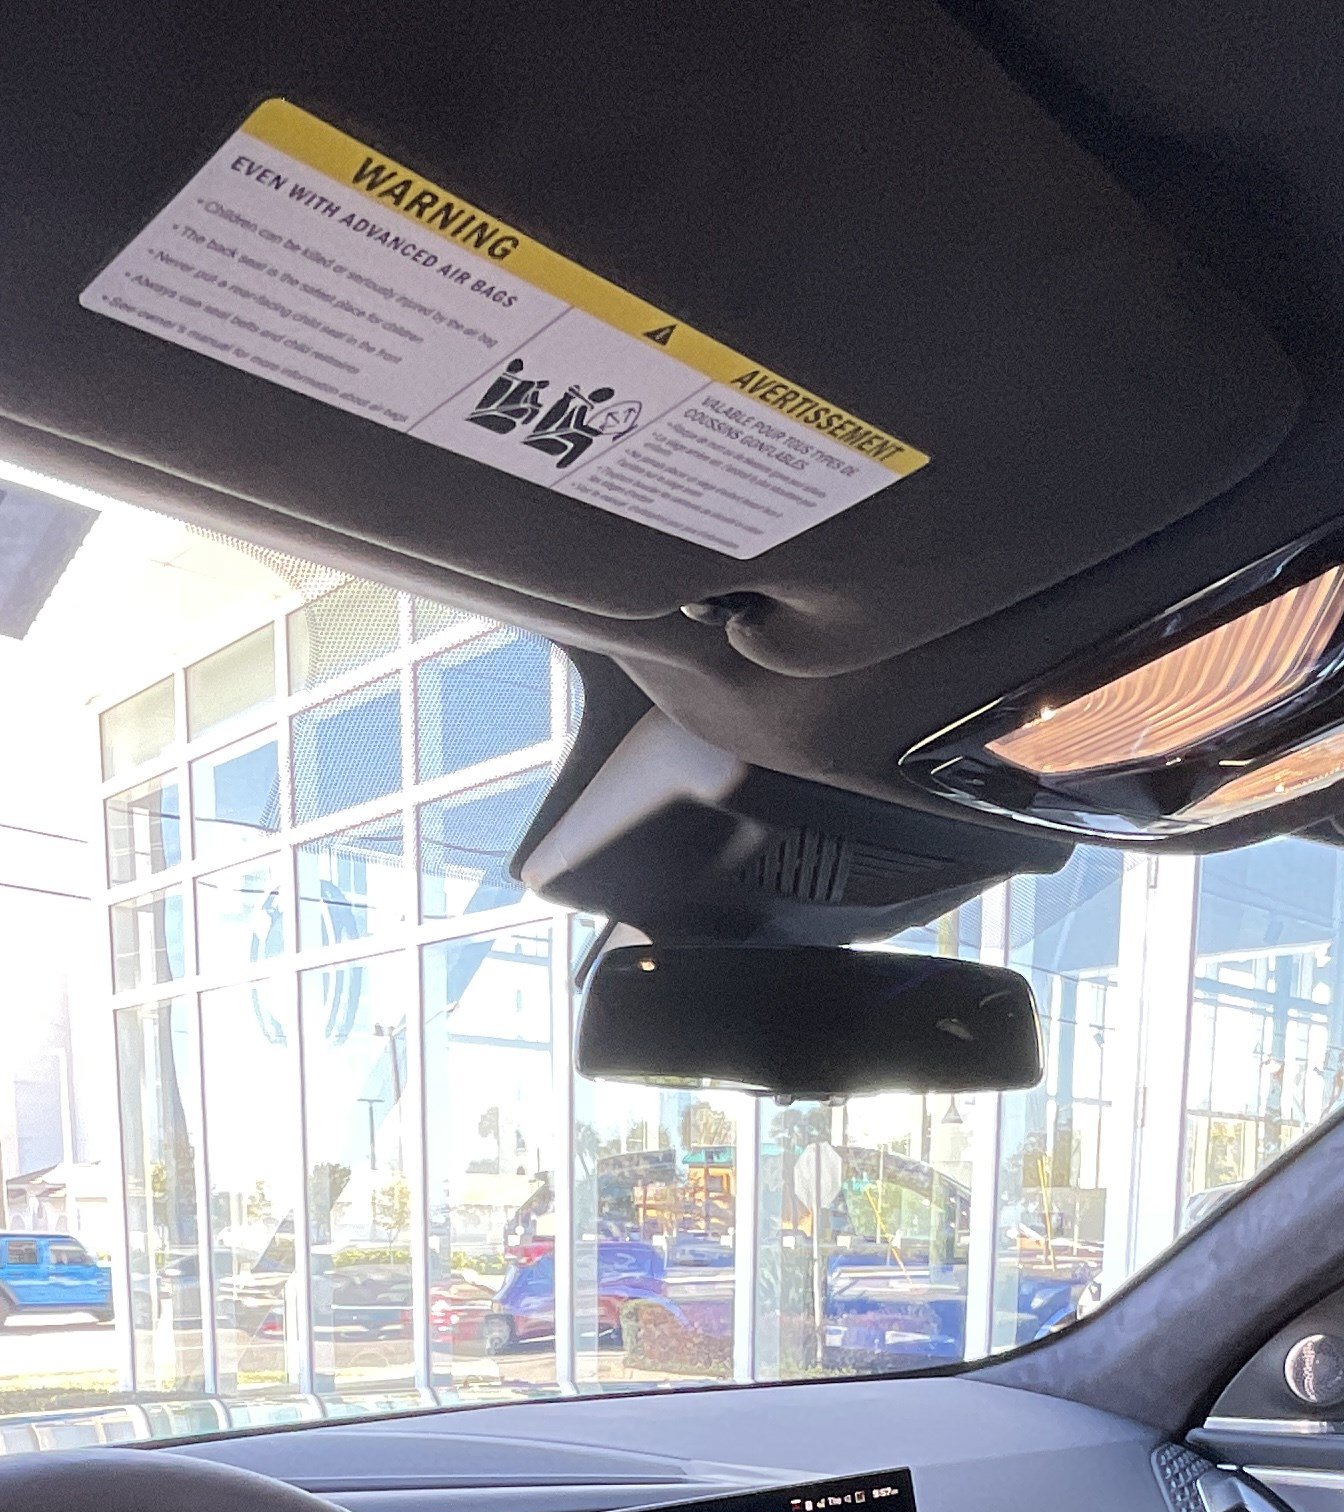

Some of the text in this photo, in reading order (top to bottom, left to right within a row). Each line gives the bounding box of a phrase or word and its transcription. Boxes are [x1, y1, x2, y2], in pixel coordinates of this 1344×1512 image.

[178, 226, 208, 244] The
[230, 157, 518, 307] EVEN WITH ADVANCED AIR BAGS
[352, 157, 519, 260] WARNING
[683, 408, 743, 438] COUSSINS
[700, 397, 754, 424] VALABLE
[750, 421, 786, 440] POUR
[731, 369, 905, 463] AVERTISSEMENT
